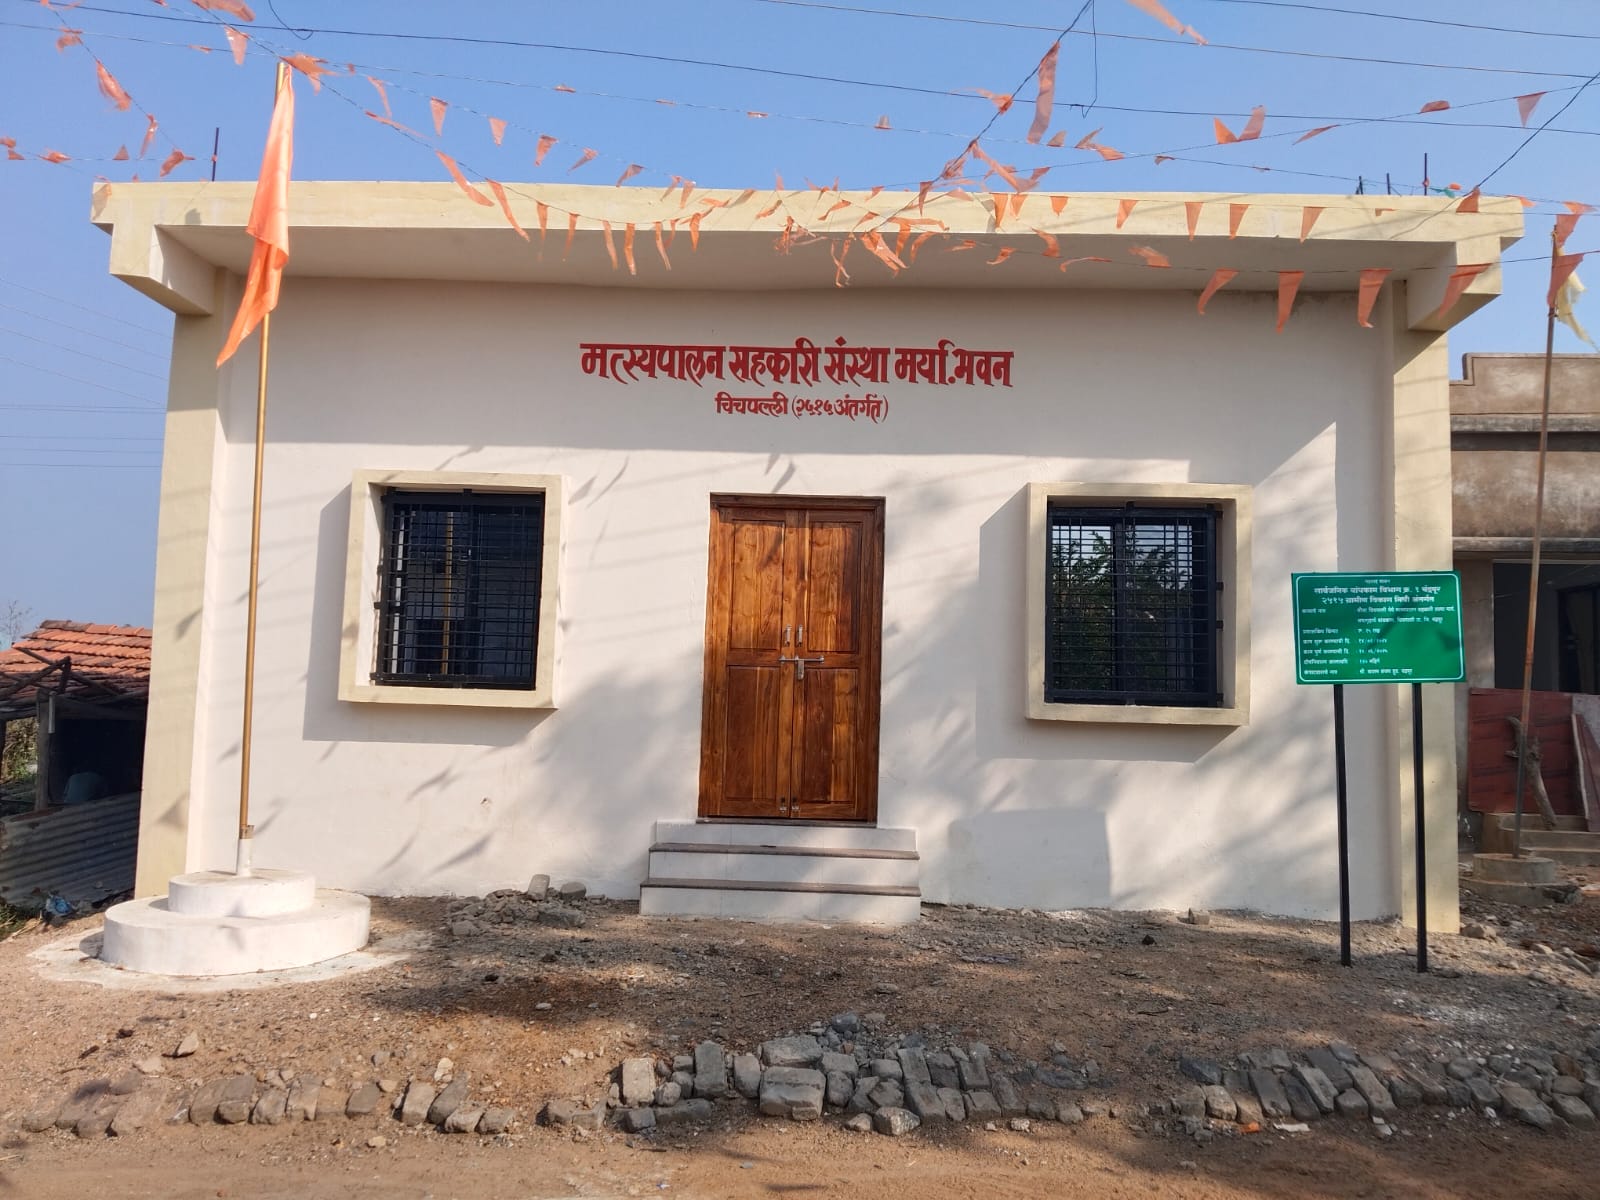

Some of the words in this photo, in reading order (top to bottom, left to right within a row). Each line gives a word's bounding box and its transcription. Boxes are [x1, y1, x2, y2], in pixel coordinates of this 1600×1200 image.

[579, 342, 727, 387] मत्स्यपालन
[728, 336, 821, 387] सहकारी
[824, 336, 890, 386] संस्था
[715, 391, 788, 417] चिचपल्ली
